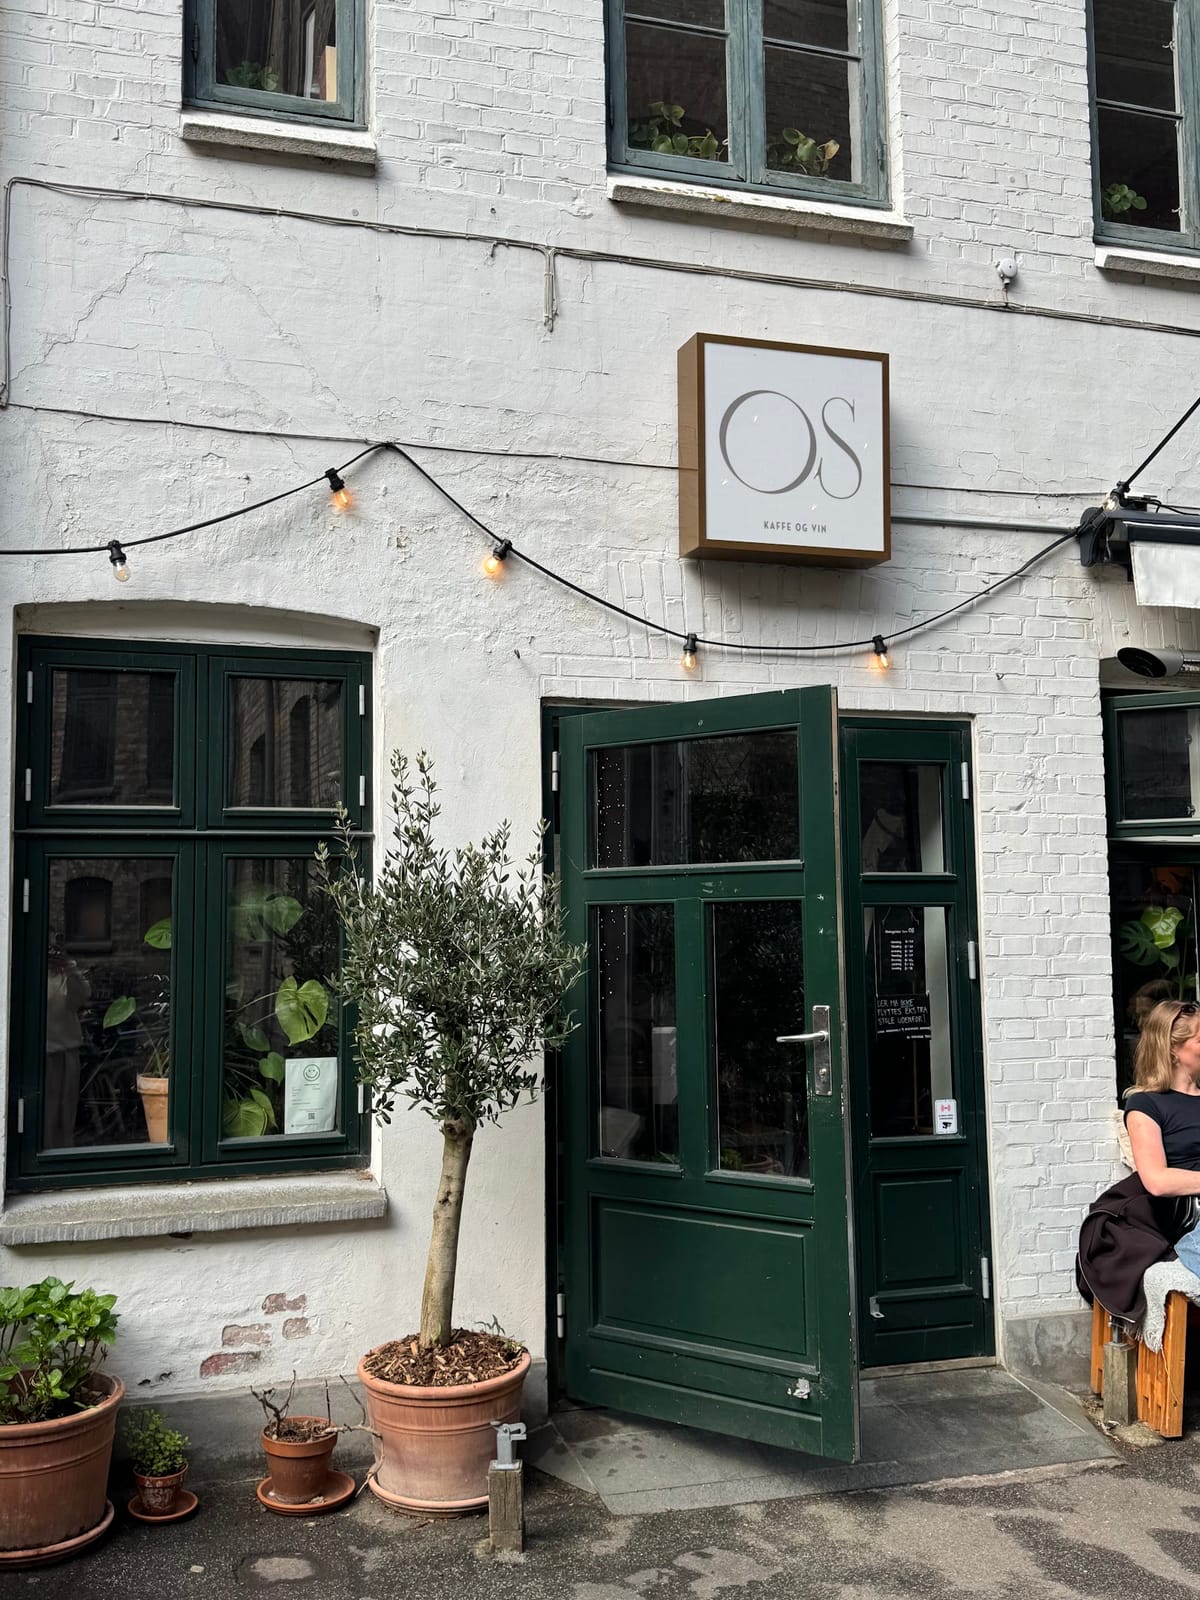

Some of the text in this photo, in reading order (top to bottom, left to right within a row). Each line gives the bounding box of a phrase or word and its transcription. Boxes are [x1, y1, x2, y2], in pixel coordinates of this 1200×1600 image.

[719, 389, 862, 500] OS
[763, 520, 827, 534] KAFFE OG VIN
